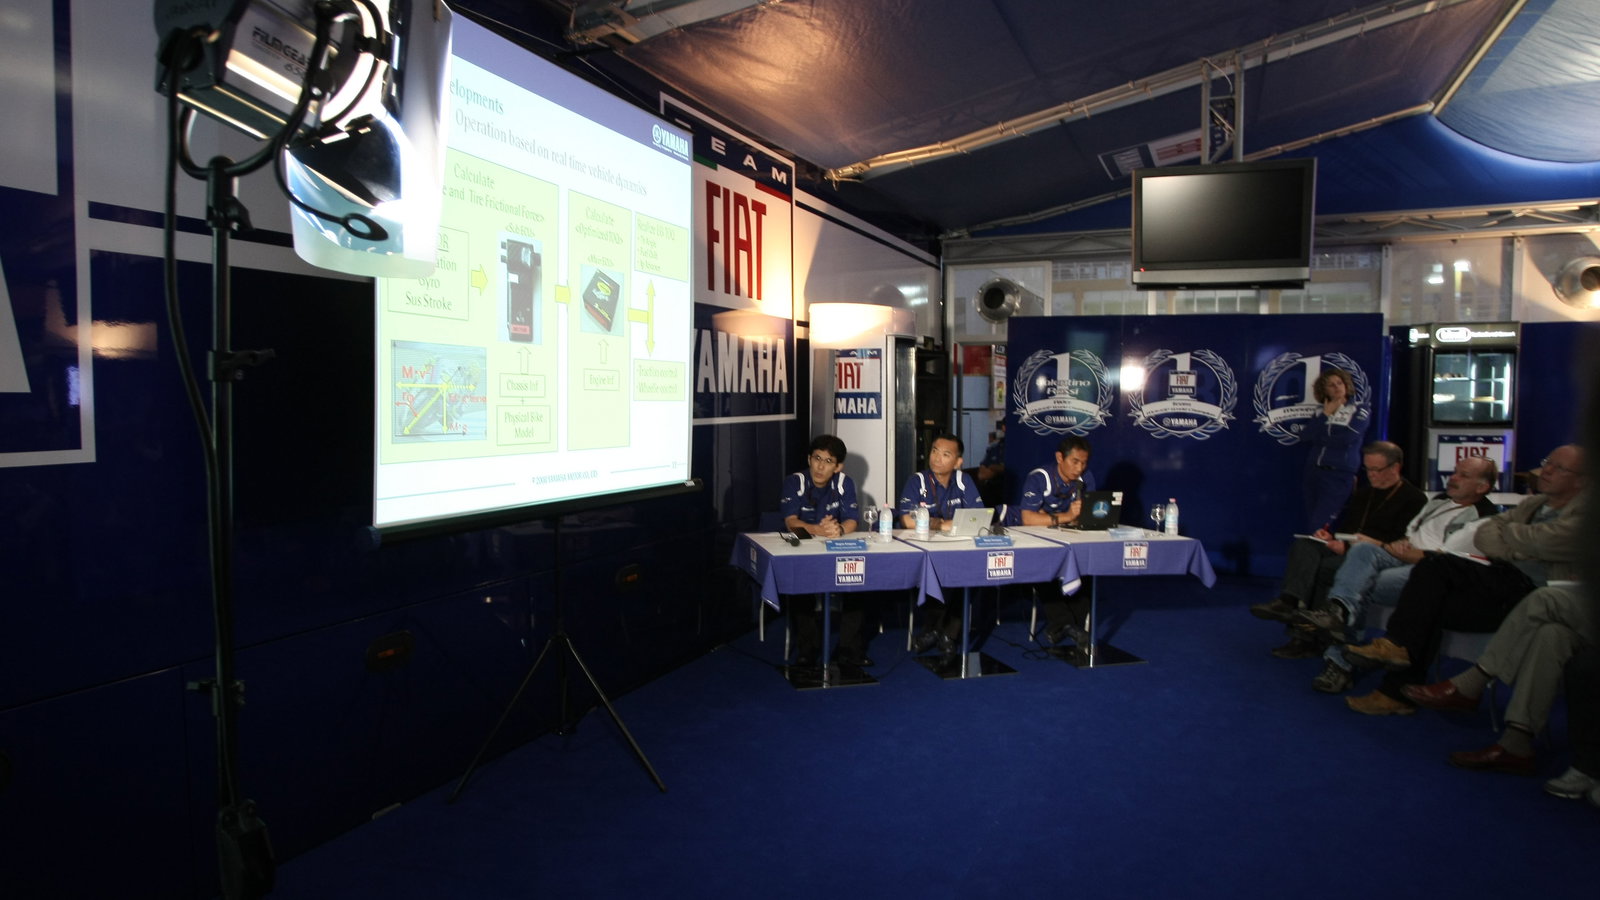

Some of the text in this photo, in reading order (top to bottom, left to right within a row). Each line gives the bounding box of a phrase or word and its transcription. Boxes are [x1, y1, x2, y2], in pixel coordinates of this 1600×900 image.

[252, 26, 311, 66] FILMGEA
[449, 79, 504, 115] elopments
[455, 108, 647, 196] Operation based on real time vehicle dynamics
[661, 128, 689, 157] YAMAHA
[453, 162, 496, 190] Calculate
[448, 186, 465, 200] and
[468, 188, 484, 207] Tire
[705, 180, 767, 301] FIAT
[405, 290, 452, 311] Sus Stroke
[835, 361, 864, 389] IAT
[1036, 377, 1091, 388] alentino
[835, 397, 878, 414] MAHA
[1052, 415, 1078, 424] YAMAHA
[1171, 418, 1198, 426] YAMAHA
[843, 562, 858, 573] FIAT
[994, 556, 1007, 568] FIAT
[838, 575, 862, 583] YAMAHA
[989, 569, 1012, 577] YAMAHA
